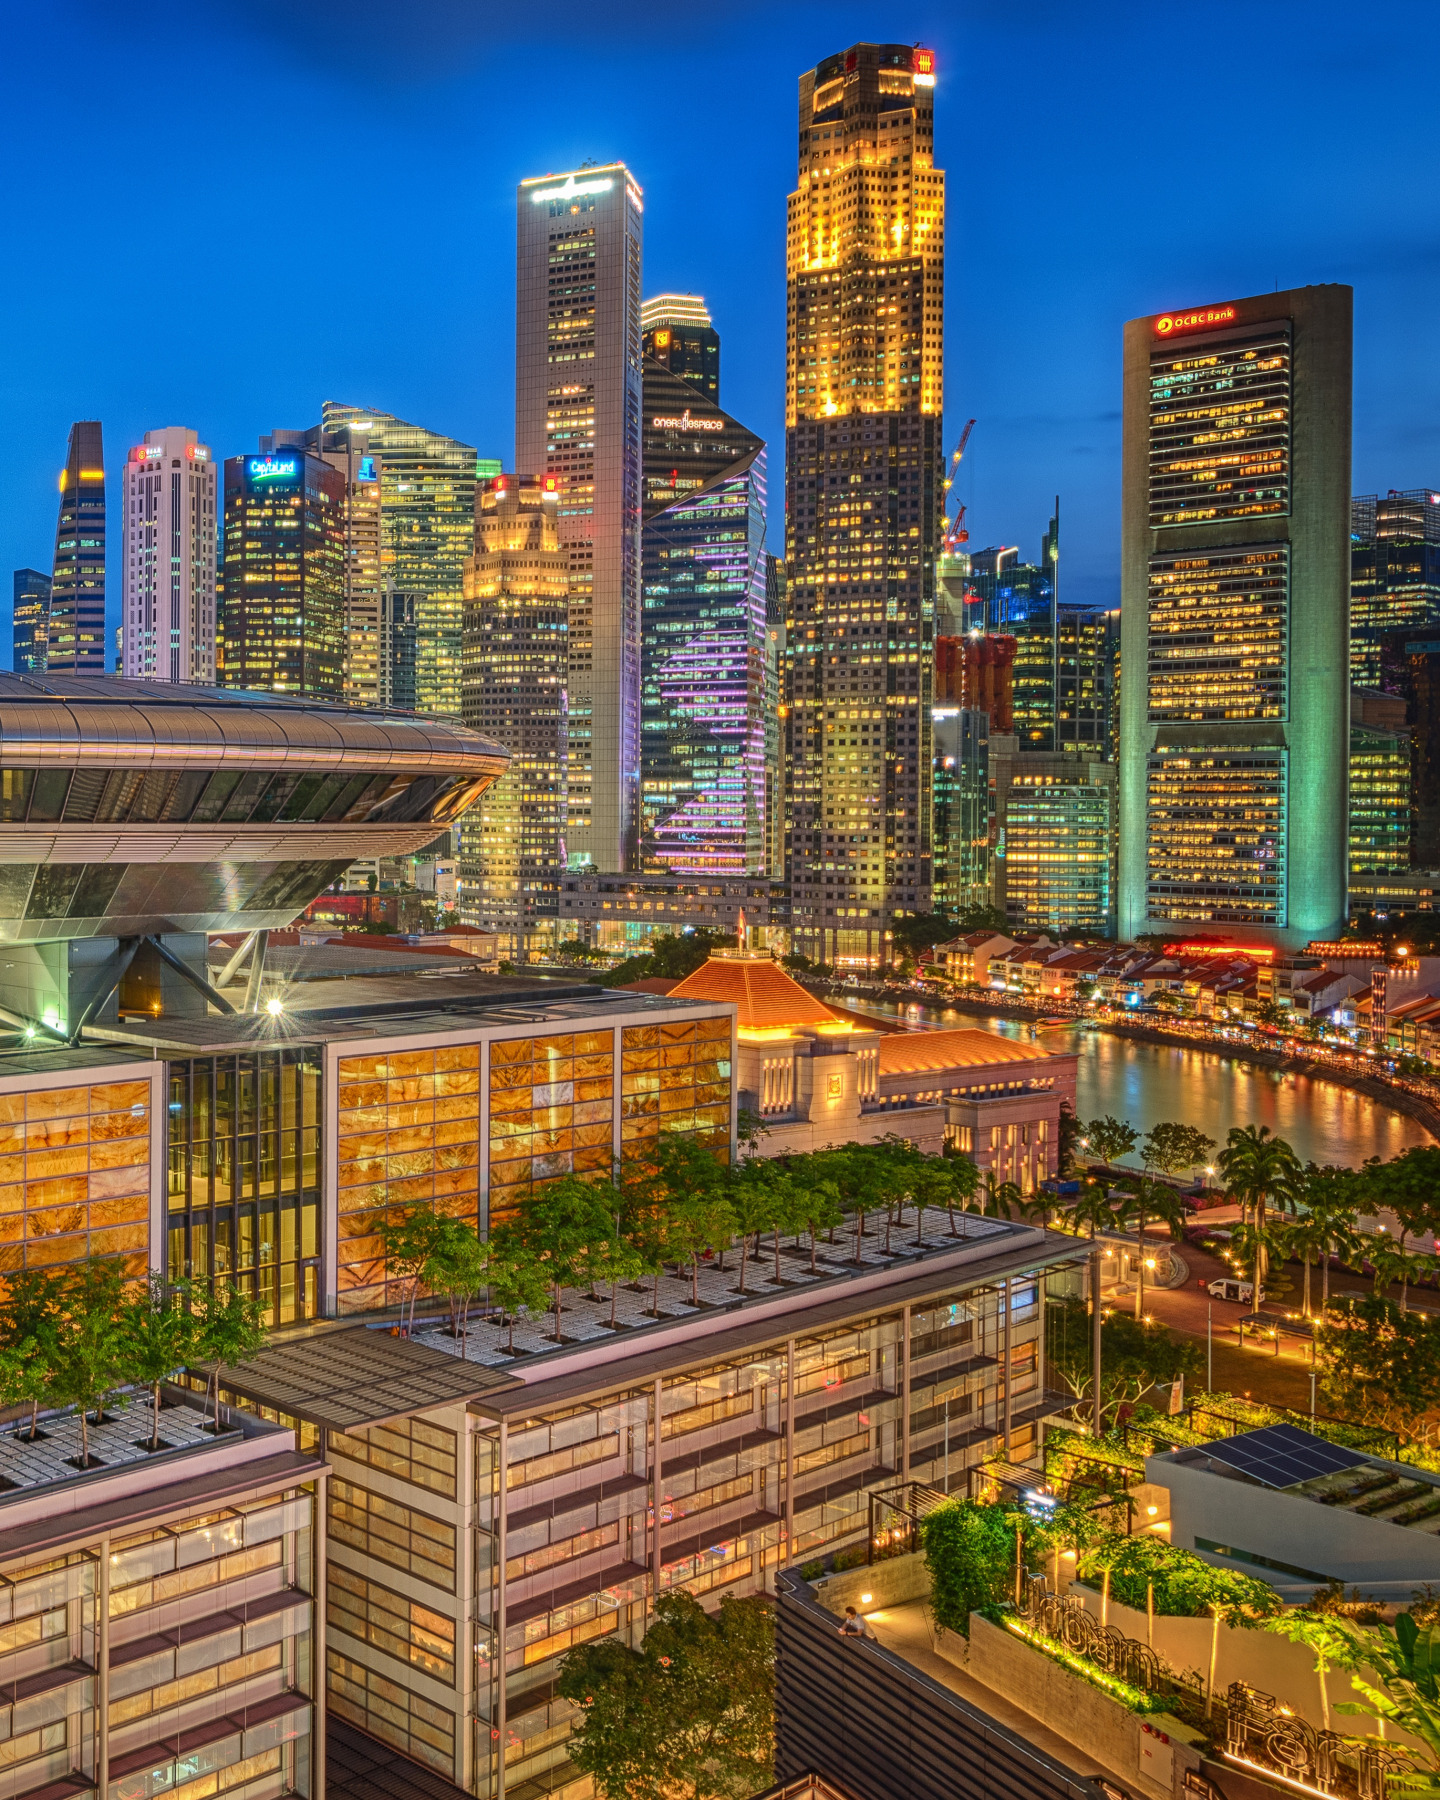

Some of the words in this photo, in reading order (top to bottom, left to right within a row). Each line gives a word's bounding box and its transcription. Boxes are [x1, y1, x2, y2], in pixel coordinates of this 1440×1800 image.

[1174, 314, 1205, 327] OCBC
[1207, 308, 1233, 322] Bank
[1010, 1562, 1160, 1696] Urban
[1227, 1681, 1422, 1800] Farm
